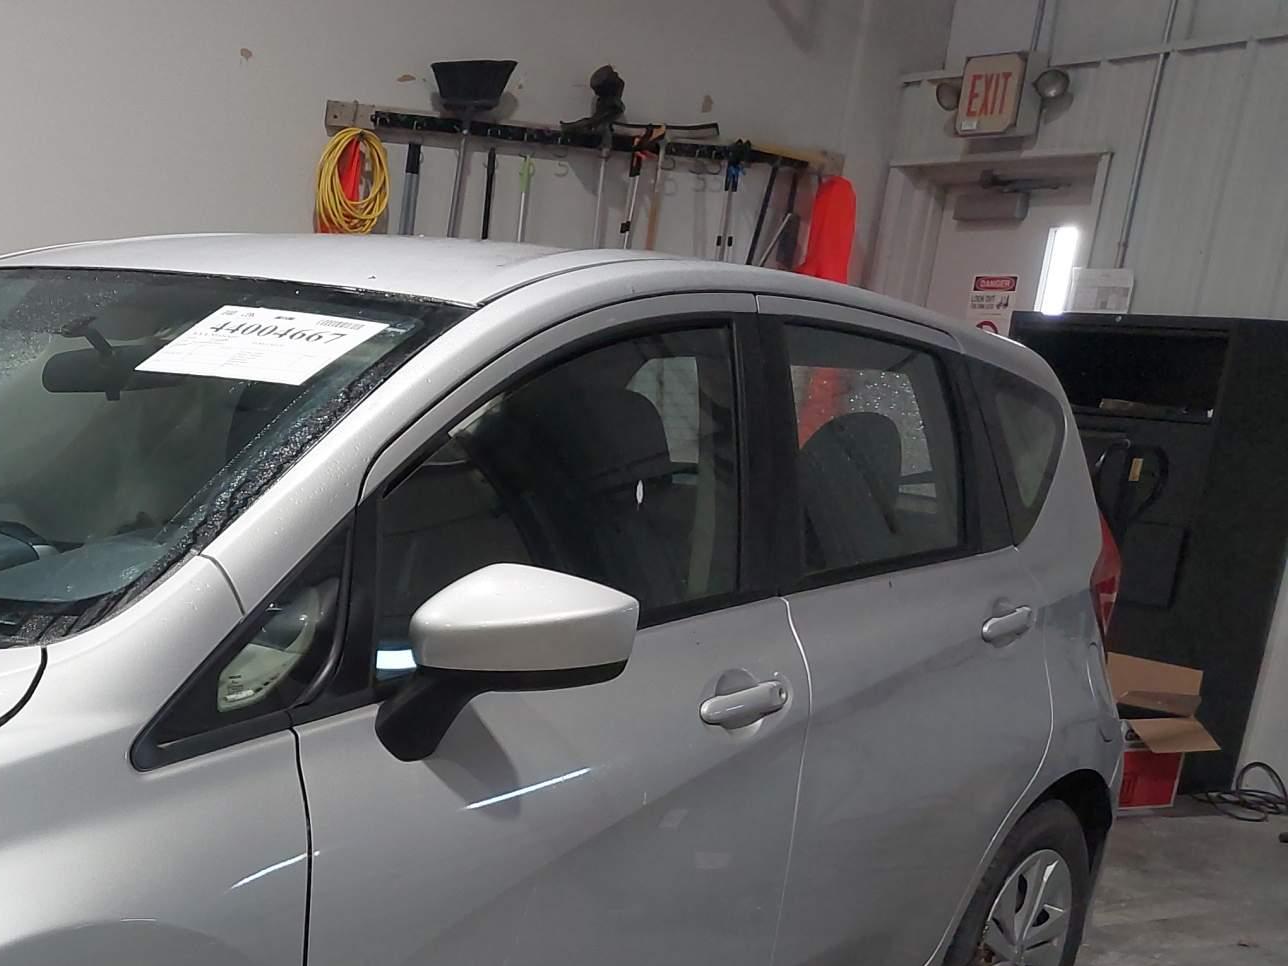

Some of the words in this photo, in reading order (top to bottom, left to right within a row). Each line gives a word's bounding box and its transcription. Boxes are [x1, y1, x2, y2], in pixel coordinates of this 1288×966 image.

[966, 71, 1013, 117] EXIT
[980, 280, 1011, 288] DANGER
[210, 321, 348, 345] 44004667
